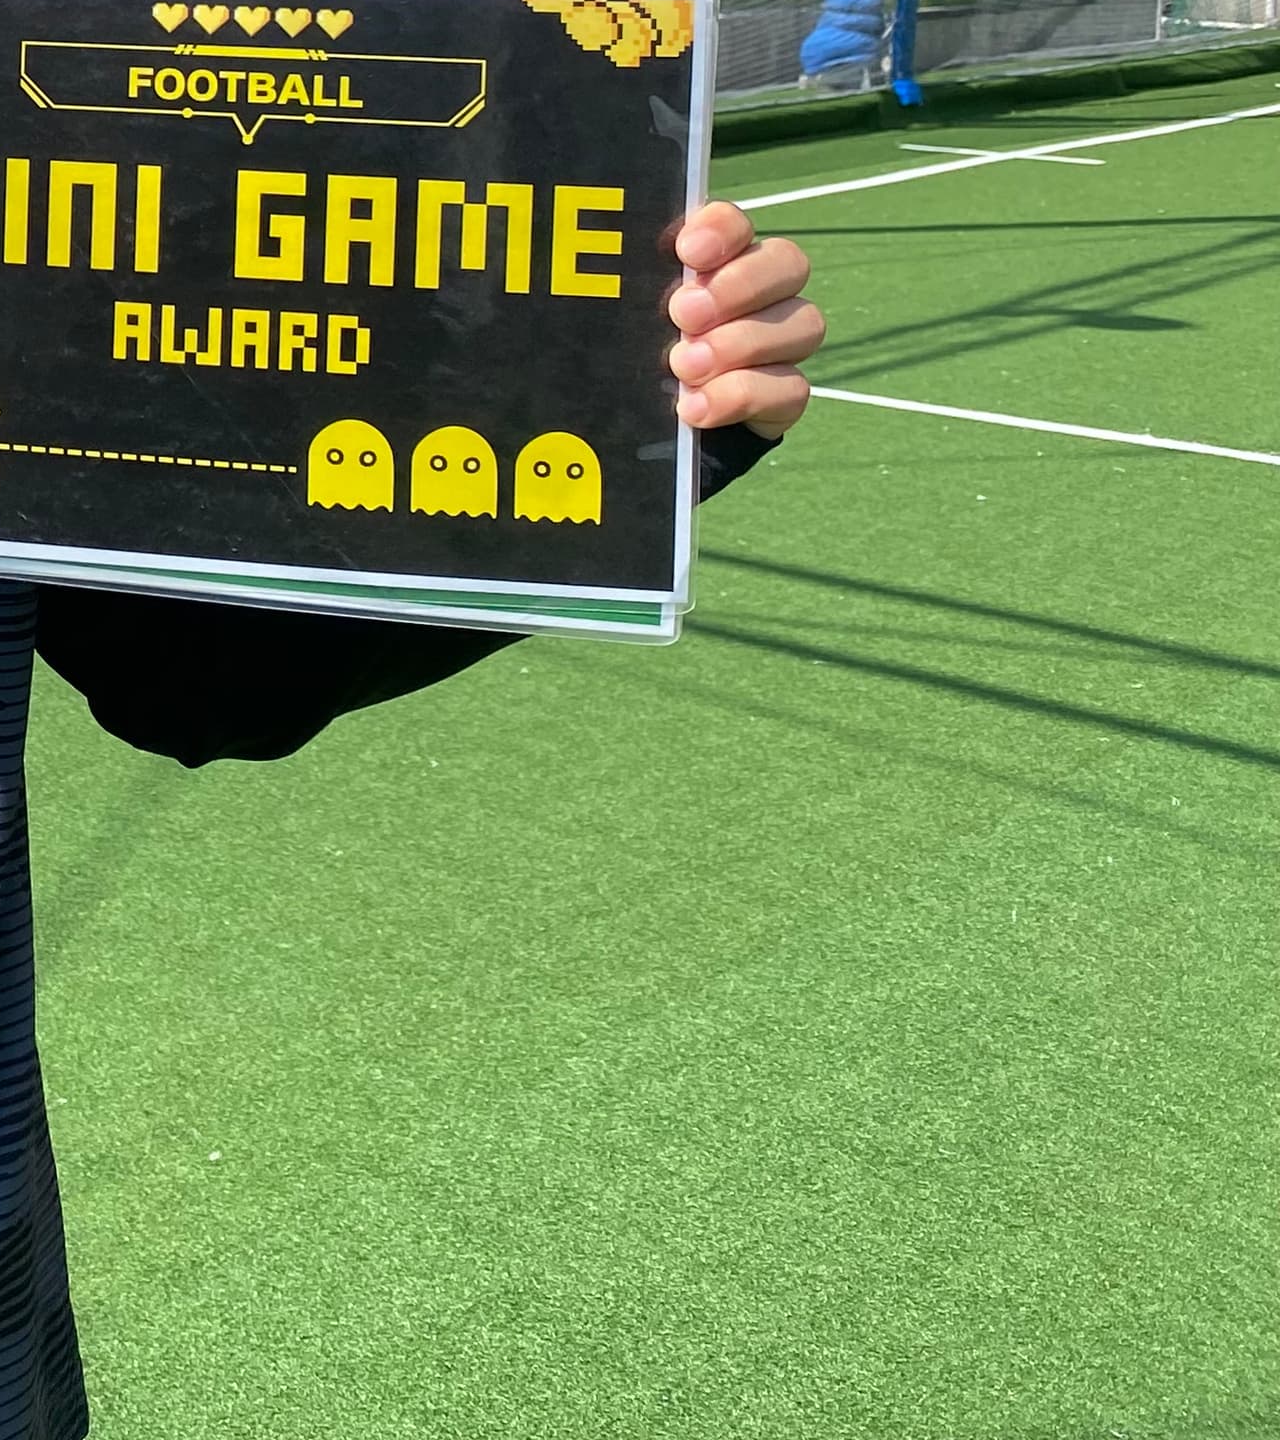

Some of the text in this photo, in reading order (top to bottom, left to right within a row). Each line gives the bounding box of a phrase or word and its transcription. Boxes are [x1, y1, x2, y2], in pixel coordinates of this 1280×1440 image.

[127, 66, 364, 109] FOOTBALL
[234, 169, 625, 298] GAME
[113, 301, 371, 375] AWARD
